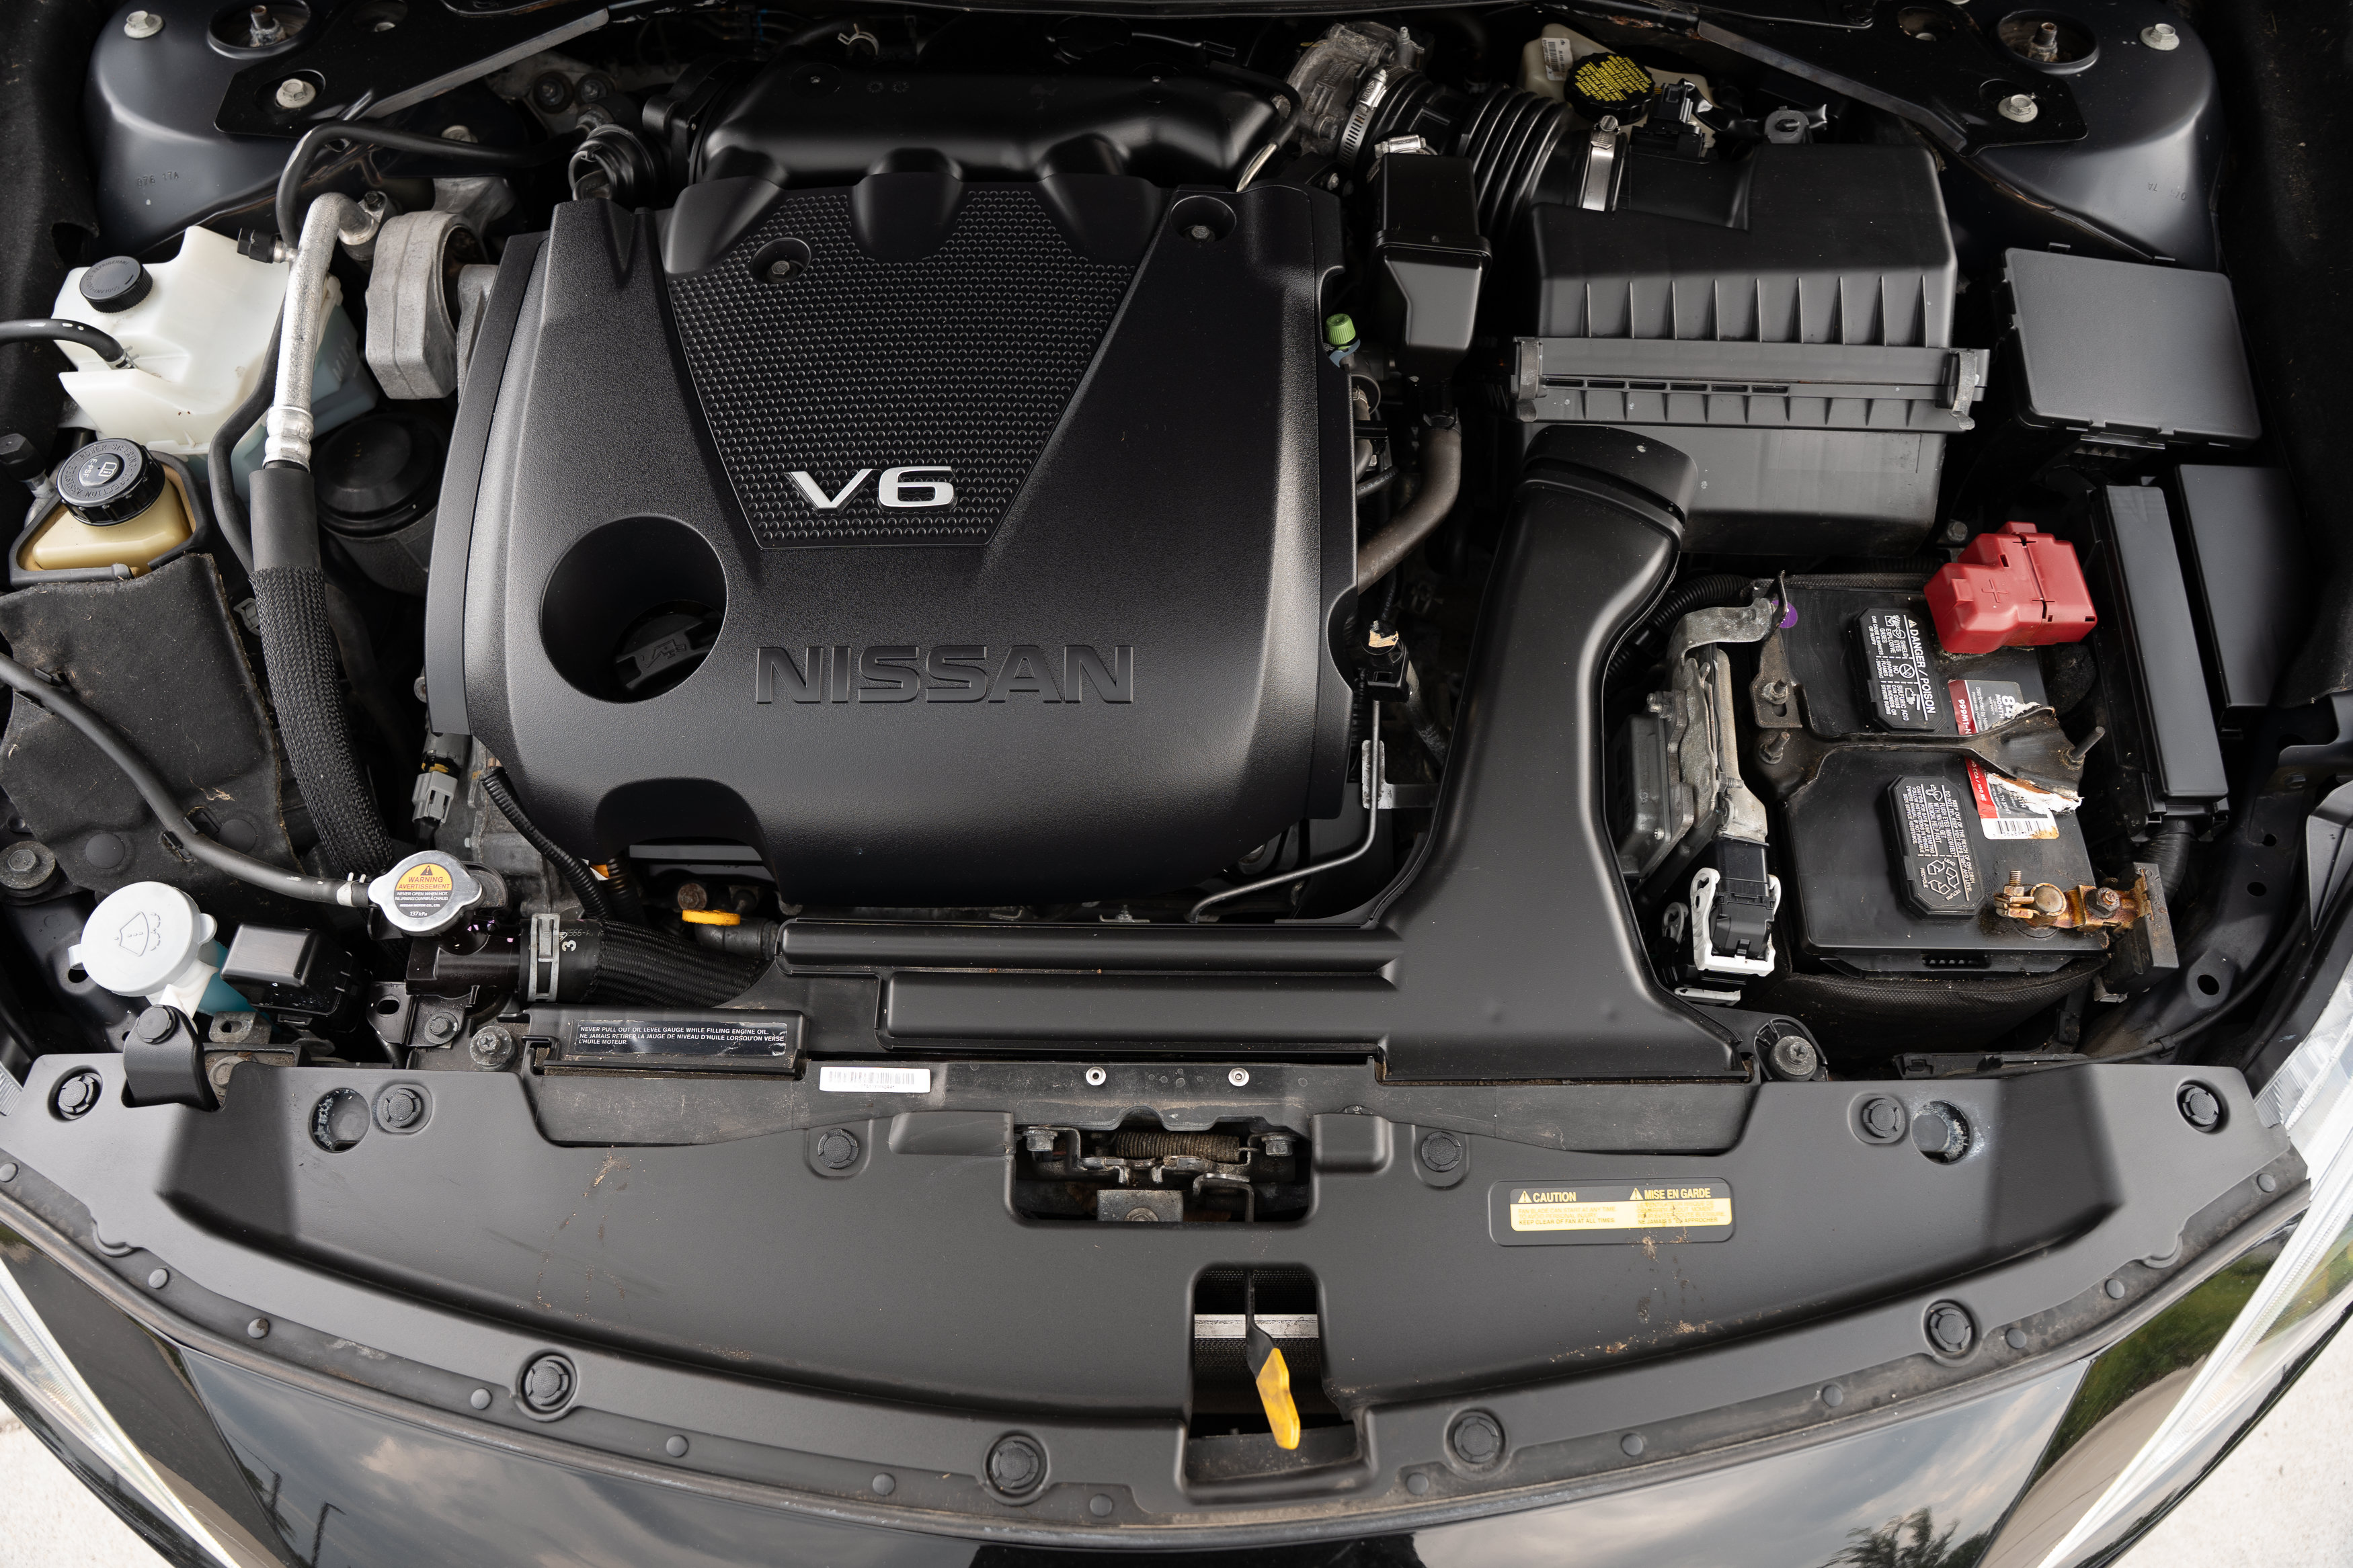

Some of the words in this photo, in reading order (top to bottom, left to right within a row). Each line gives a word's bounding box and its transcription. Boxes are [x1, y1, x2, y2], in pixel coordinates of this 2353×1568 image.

[78, 444, 108, 460] POWER
[83, 458, 97, 478] E-PSF
[787, 466, 957, 513] V6
[1876, 636, 1884, 655] BLINDNESS
[1886, 628, 1896, 653] EXPLOSIVE
[1900, 641, 1908, 657] SHIELD
[756, 646, 1134, 704] NISSAN
[1876, 661, 1884, 678] SMOKING
[1892, 665, 1899, 674] NO
[1910, 630, 1925, 667] DANGER
[1921, 678, 1936, 713] POISON
[1886, 685, 1895, 708] BLINDNESS
[1897, 686, 1906, 708] SULFURIC
[2002, 696, 2017, 718] 84
[1915, 803, 1925, 830] INSTRUCTIONS
[1927, 802, 1936, 820] MEDICAL
[1916, 833, 1925, 853] AVAILABLE
[1927, 835, 1935, 853] STARTING
[1946, 828, 1956, 855] IMMEDIATELY
[1958, 854, 1966, 868] TIGHT
[1920, 868, 1928, 888] RECYCLE
[1966, 862, 1975, 883] CHILDREN
[1946, 889, 1960, 900] RETURN
[561, 940, 577, 952] 3
[1533, 1192, 1576, 1202] CAUTION
[1644, 1190, 1665, 1199] MISE
[1667, 1189, 1679, 1199] EN
[1681, 1188, 1710, 1198] GARDE
